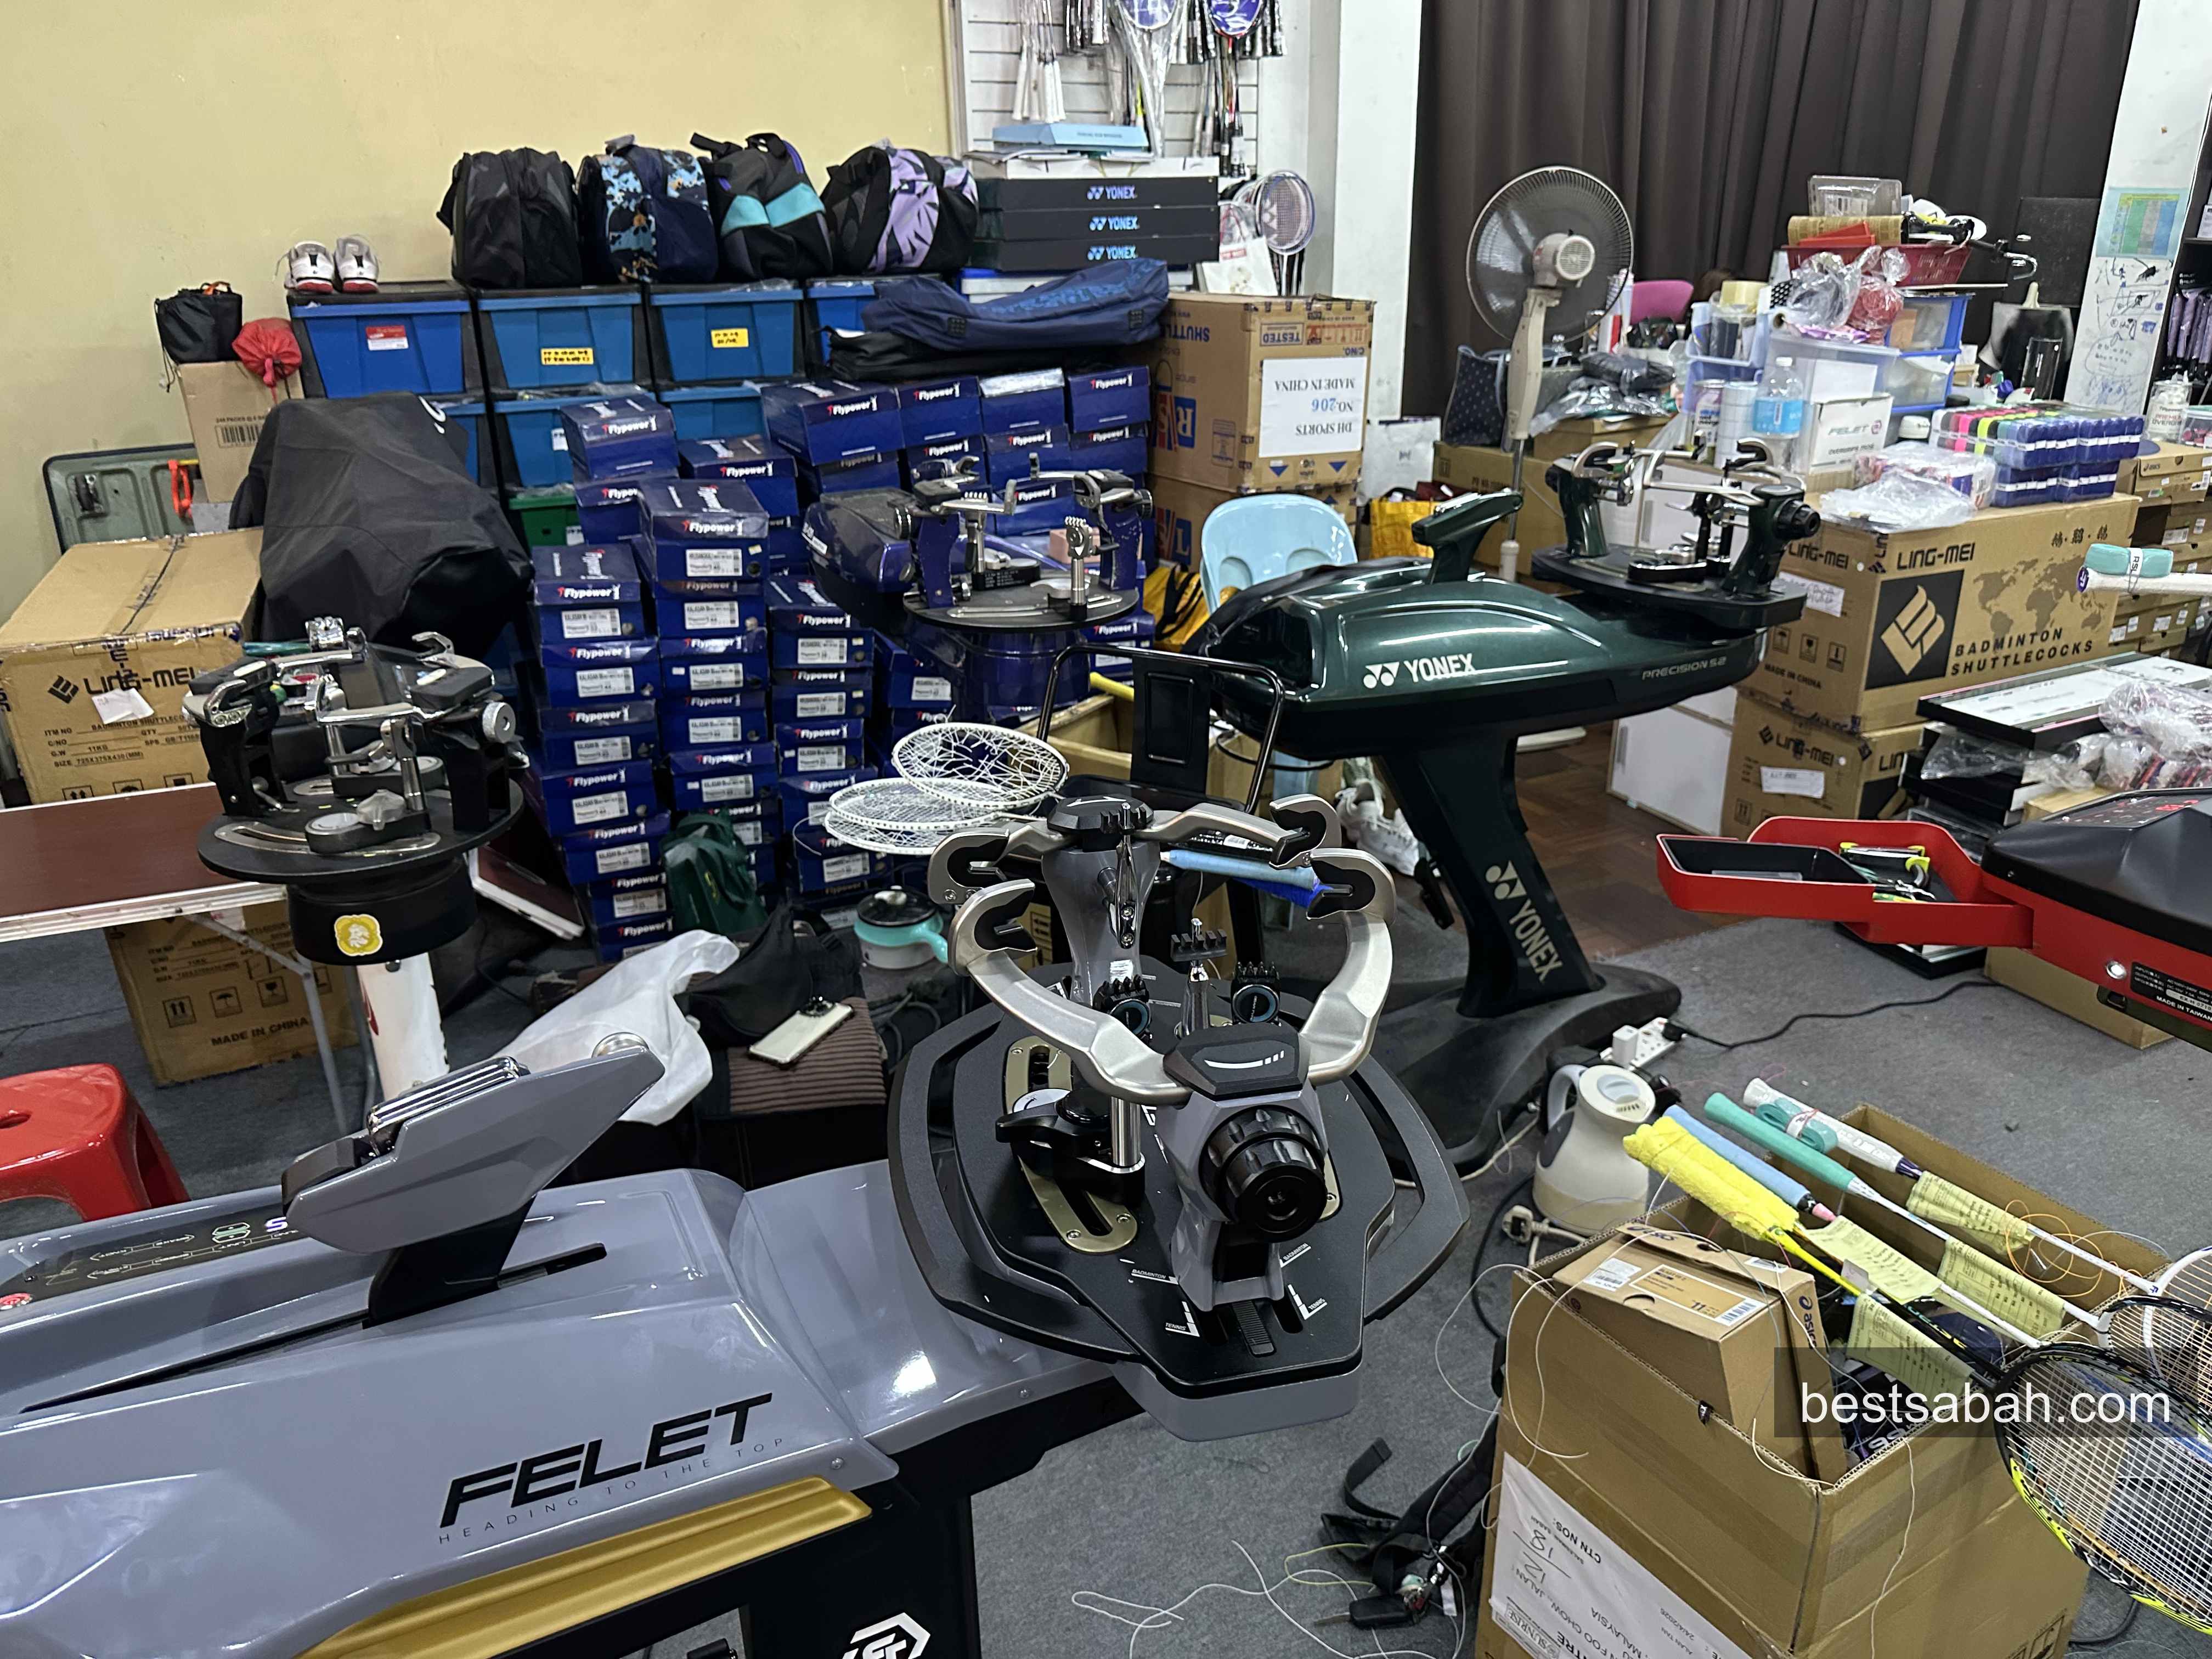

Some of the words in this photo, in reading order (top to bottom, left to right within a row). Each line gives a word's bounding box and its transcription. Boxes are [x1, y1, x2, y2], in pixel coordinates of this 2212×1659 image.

[1106, 186, 1136, 200] YONEX
[1109, 216, 1138, 230] YONEX
[1106, 246, 1137, 260] YONEX
[1263, 332, 1301, 344] TESTED
[1096, 377, 1128, 390] Flypower
[1274, 380, 1309, 391] CHINA
[1311, 379, 1324, 389] IN
[1324, 377, 1356, 390] MADE
[919, 387, 955, 401] Flypower
[834, 403, 870, 415] Flypower
[608, 421, 648, 433] Flypower
[1295, 423, 1336, 436] SPORTS
[1337, 422, 1352, 434] DH
[1013, 433, 1046, 445] Flypower
[1094, 430, 1125, 441] Flypower
[929, 443, 963, 455] Flypower
[727, 466, 768, 477] Flypower
[1018, 488, 1051, 500] Flypower
[690, 522, 735, 534] Flypower
[1788, 543, 1849, 569] LING-MEI
[1897, 543, 1975, 570] LING-MEI
[565, 589, 611, 599] Flypower
[806, 616, 845, 626] Flypower
[1099, 624, 1133, 634] Flypower
[1955, 628, 2063, 657] BADMINTON
[578, 648, 621, 659] Flypower
[1951, 640, 2094, 676] SHUTTLECOCKS
[1404, 653, 1477, 682] YONEX
[1641, 660, 1708, 680] PRECISION
[1764, 663, 1785, 676] MADE
[1787, 670, 1796, 680] IN
[797, 672, 838, 682] Flypower
[576, 710, 620, 723] Flypower
[44, 727, 59, 736] ITM
[801, 728, 840, 740] Flypower
[54, 759, 72, 768] SIZE
[701, 753, 746, 764] Flypower
[574, 773, 617, 786] Flypower
[809, 778, 849, 790] Flypower
[595, 825, 637, 838] Flypower
[617, 876, 662, 888] Flypower
[624, 922, 667, 936] Flypower
[1509, 898, 1563, 983] YONEX
[2156, 995, 2176, 1007] MADE
[211, 1031, 247, 1046] MADE
[251, 1026, 265, 1036] IN
[269, 1017, 309, 1031] CHINA
[1283, 1243, 1309, 1261] BADMINTON
[1132, 1269, 1166, 1279] BADMINTON
[1308, 1298, 1325, 1311] TENNIS
[1165, 1322, 1187, 1331] TENNIS
[439, 1392, 773, 1528] FELET
[439, 1495, 579, 1545] HEADING
[606, 1479, 638, 1496] TO
[663, 1458, 711, 1479] THE
[736, 1437, 784, 1458] TOP
[1580, 1541, 1602, 1564] CTN
[1516, 1568, 1545, 1598] JALAN
[1508, 1608, 1548, 1650] SUNRISE
[1591, 1606, 1642, 1658] MALAYSIA
[1584, 1632, 1607, 1656] FOO
